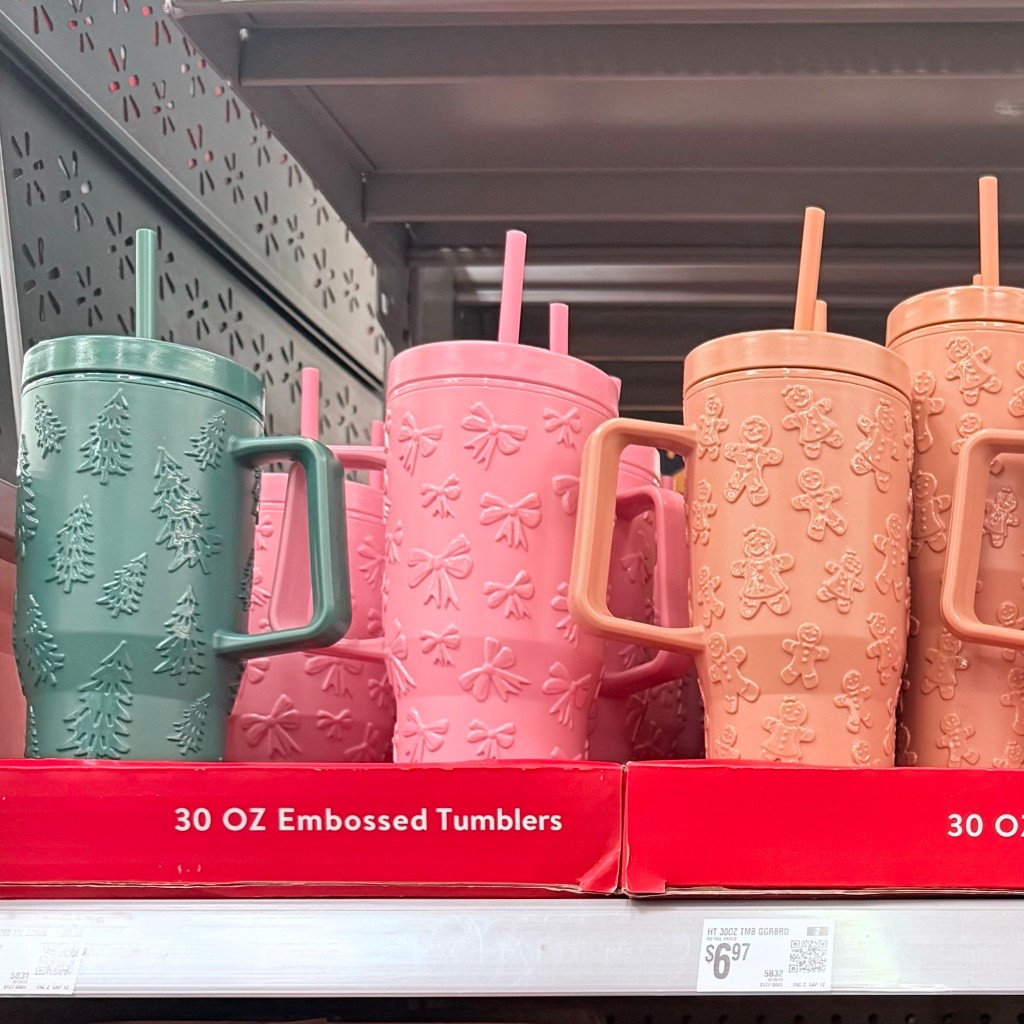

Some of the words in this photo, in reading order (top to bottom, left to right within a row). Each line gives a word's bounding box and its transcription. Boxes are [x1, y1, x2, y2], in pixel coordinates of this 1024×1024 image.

[174, 807, 211, 832] 30
[222, 807, 266, 832] OZ
[278, 807, 427, 832] Embossed
[436, 807, 563, 832] Tumblers
[947, 813, 983, 838] 30
[707, 927, 717, 936] HT
[740, 927, 756, 936] TMB
[815, 926, 820, 936] 2
[10, 971, 29, 980] 5831
[764, 969, 784, 978] 5832
